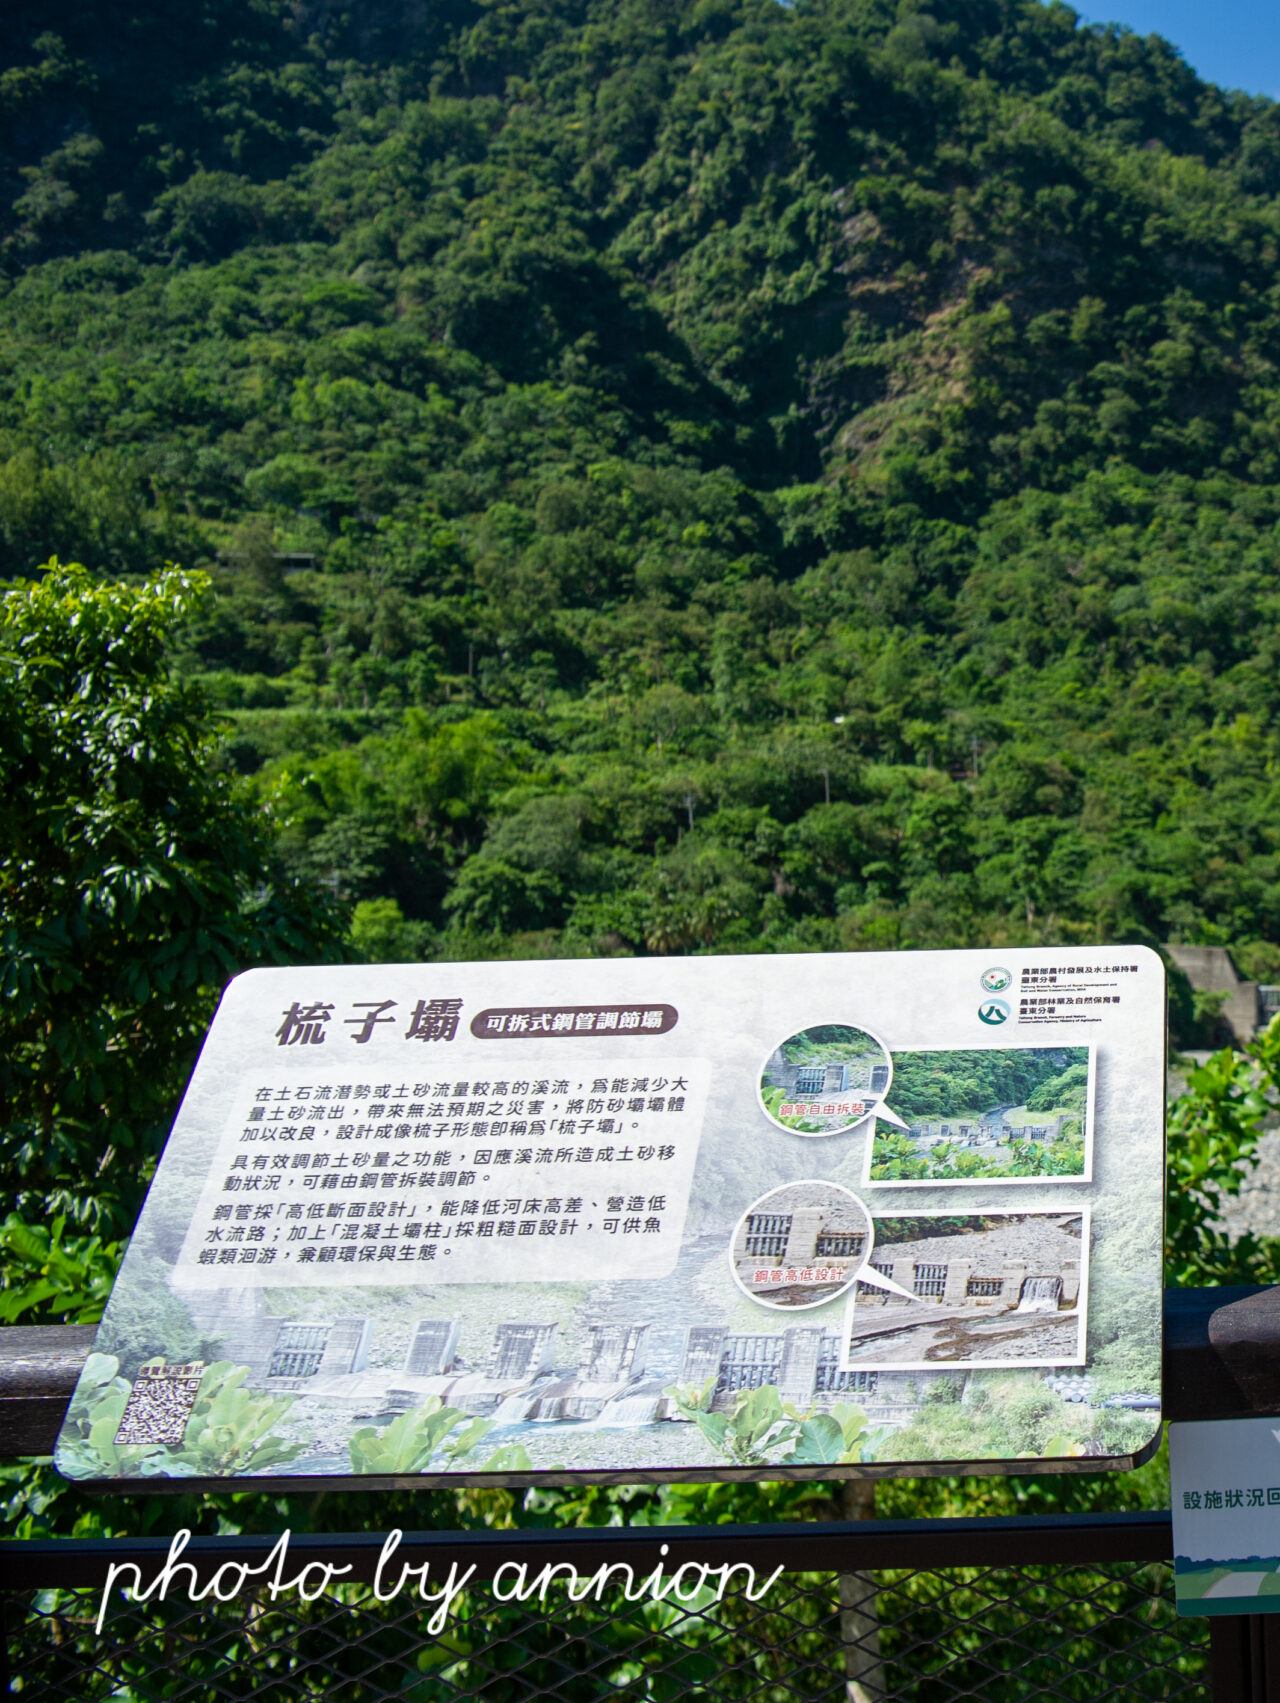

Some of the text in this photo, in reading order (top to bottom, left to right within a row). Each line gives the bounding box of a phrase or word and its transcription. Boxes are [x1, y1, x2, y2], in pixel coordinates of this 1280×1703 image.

[275, 997, 464, 1046] 梳子壩
[486, 1010, 663, 1031] 可拆式鋼管調節壩
[780, 1103, 864, 1116] 鋼管自由拆裝
[754, 1268, 844, 1282] 鋼管高低設計
